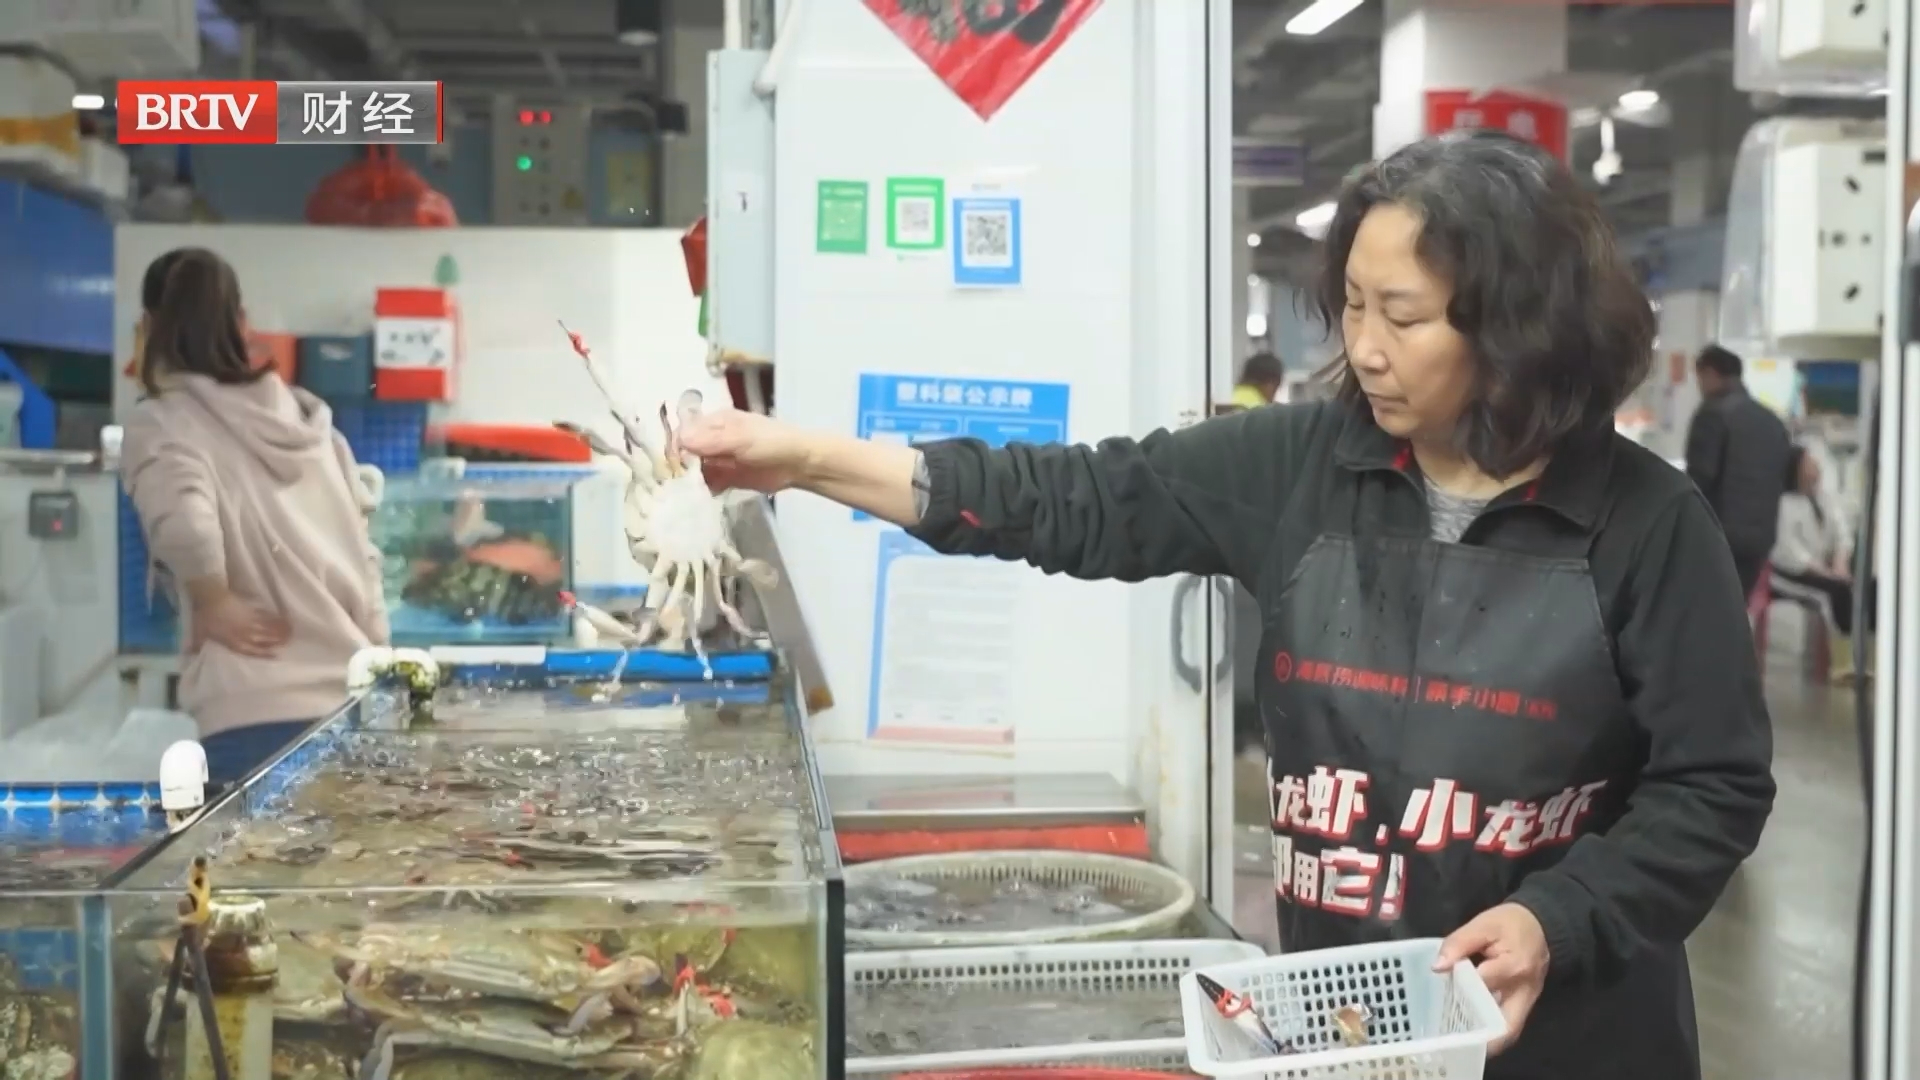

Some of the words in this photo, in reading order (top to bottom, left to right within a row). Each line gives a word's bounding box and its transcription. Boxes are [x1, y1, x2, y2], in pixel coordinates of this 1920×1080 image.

[1267, 757, 1608, 857] 龙虾，小龙虾
